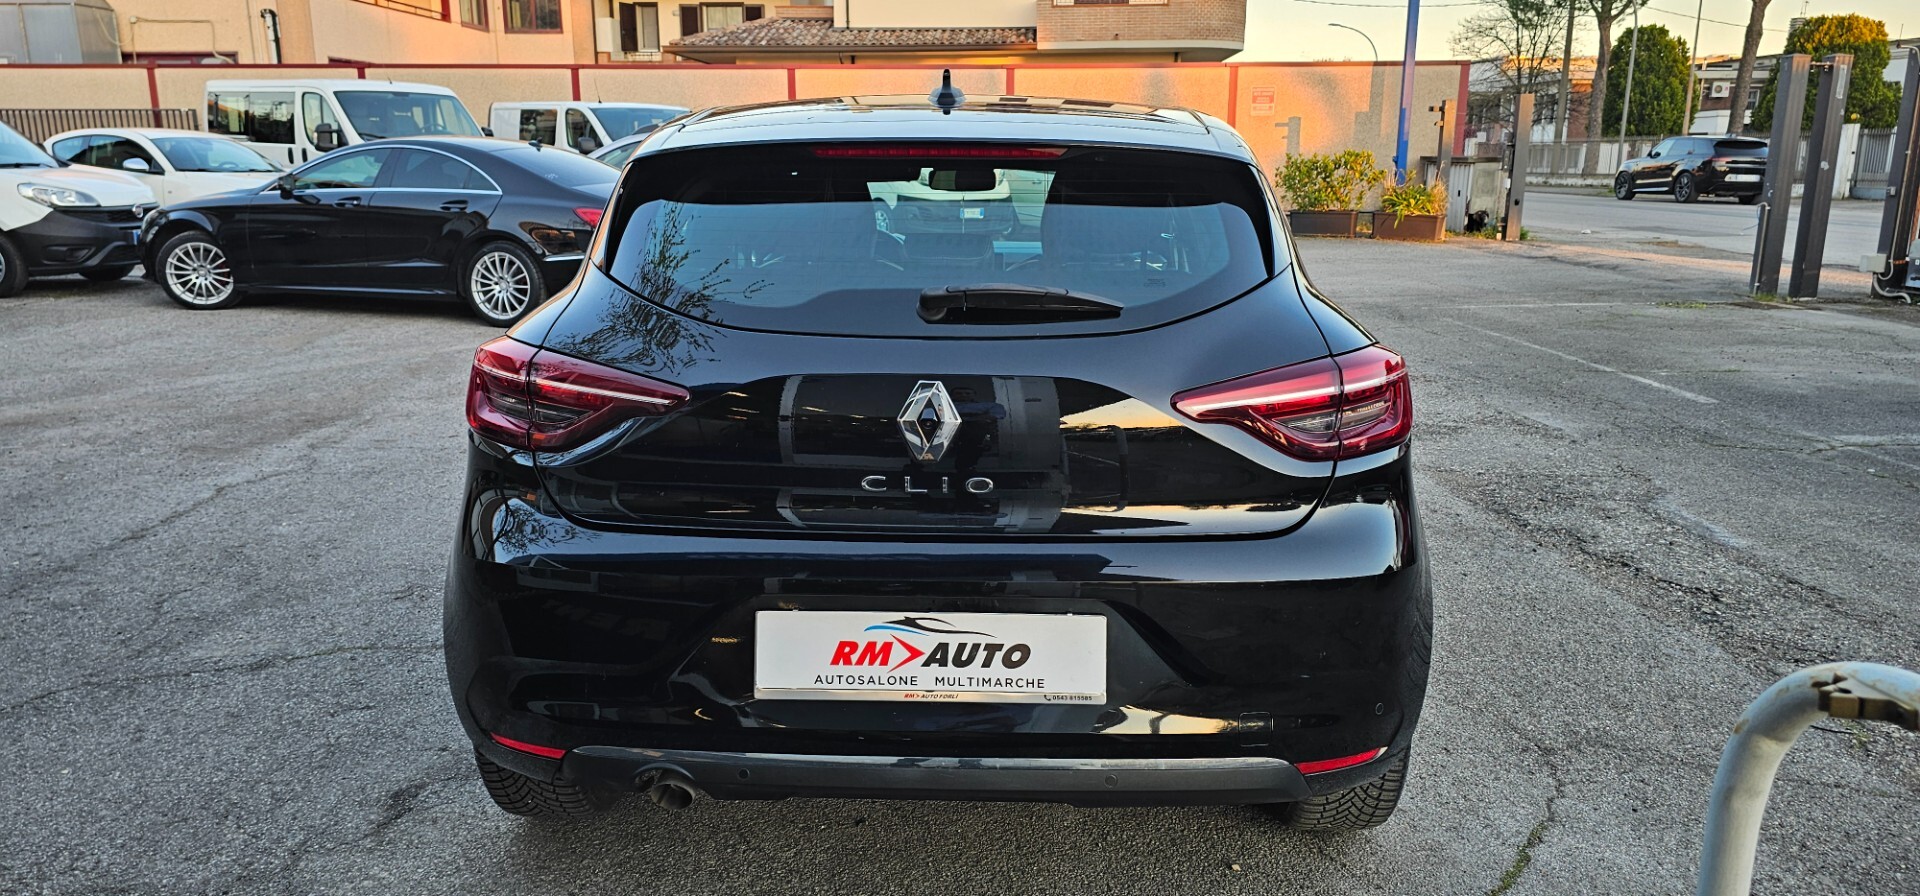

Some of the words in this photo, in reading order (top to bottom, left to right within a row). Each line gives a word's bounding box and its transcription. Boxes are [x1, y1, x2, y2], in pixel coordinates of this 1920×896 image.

[861, 475, 994, 493] CLIO
[830, 641, 894, 666] RM
[921, 643, 1031, 669] AUTO
[813, 674, 919, 687] AUTOSALONE
[934, 676, 1046, 689] MULTIMARCHE
